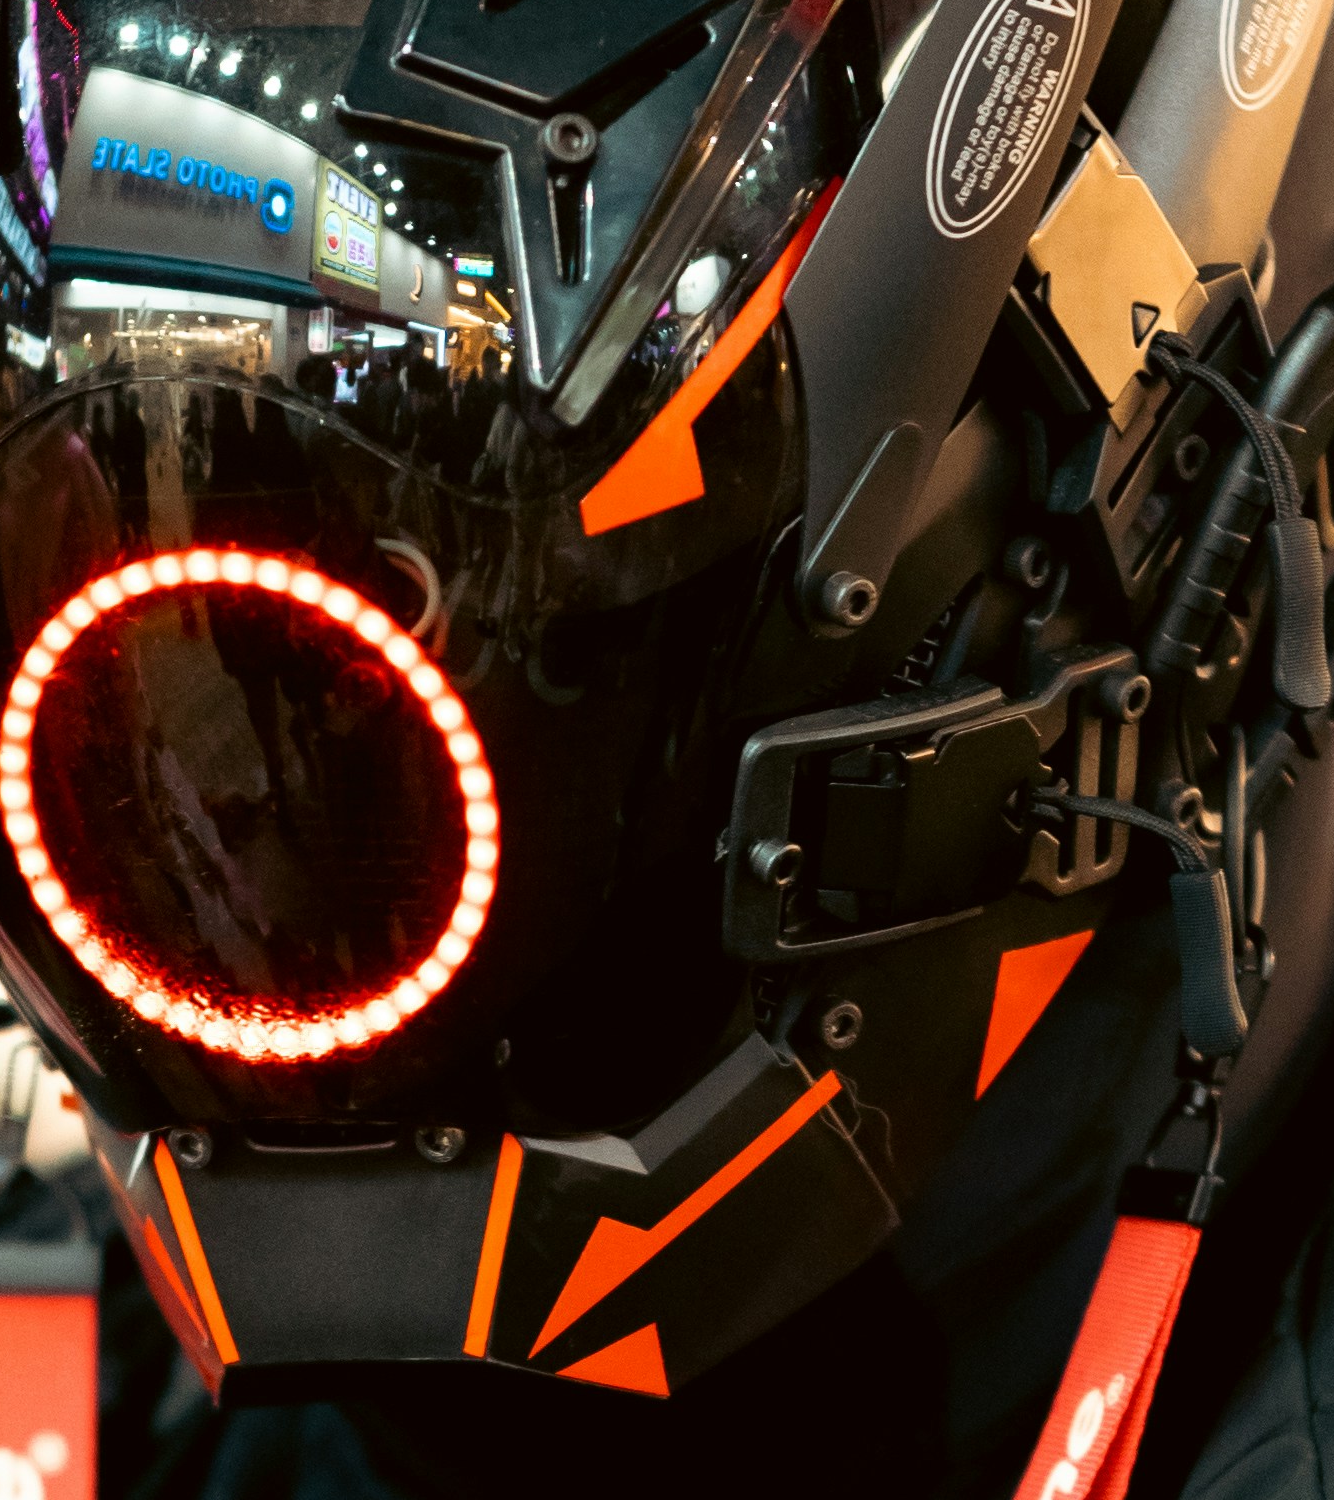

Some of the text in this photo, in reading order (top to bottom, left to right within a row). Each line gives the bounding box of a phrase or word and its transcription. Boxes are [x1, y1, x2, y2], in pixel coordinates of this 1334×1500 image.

[1004, 9, 1020, 25] to
[1031, 24, 1044, 42] or
[1040, 32, 1059, 55] Do
[1002, 43, 1036, 104] damage
[1028, 57, 1046, 83] not
[951, 17, 1031, 181] cause damage or lead
[995, 106, 1008, 124] or
[1004, 105, 1023, 136] with
[1008, 69, 1060, 166] WARNING
[979, 138, 1012, 190] broken
